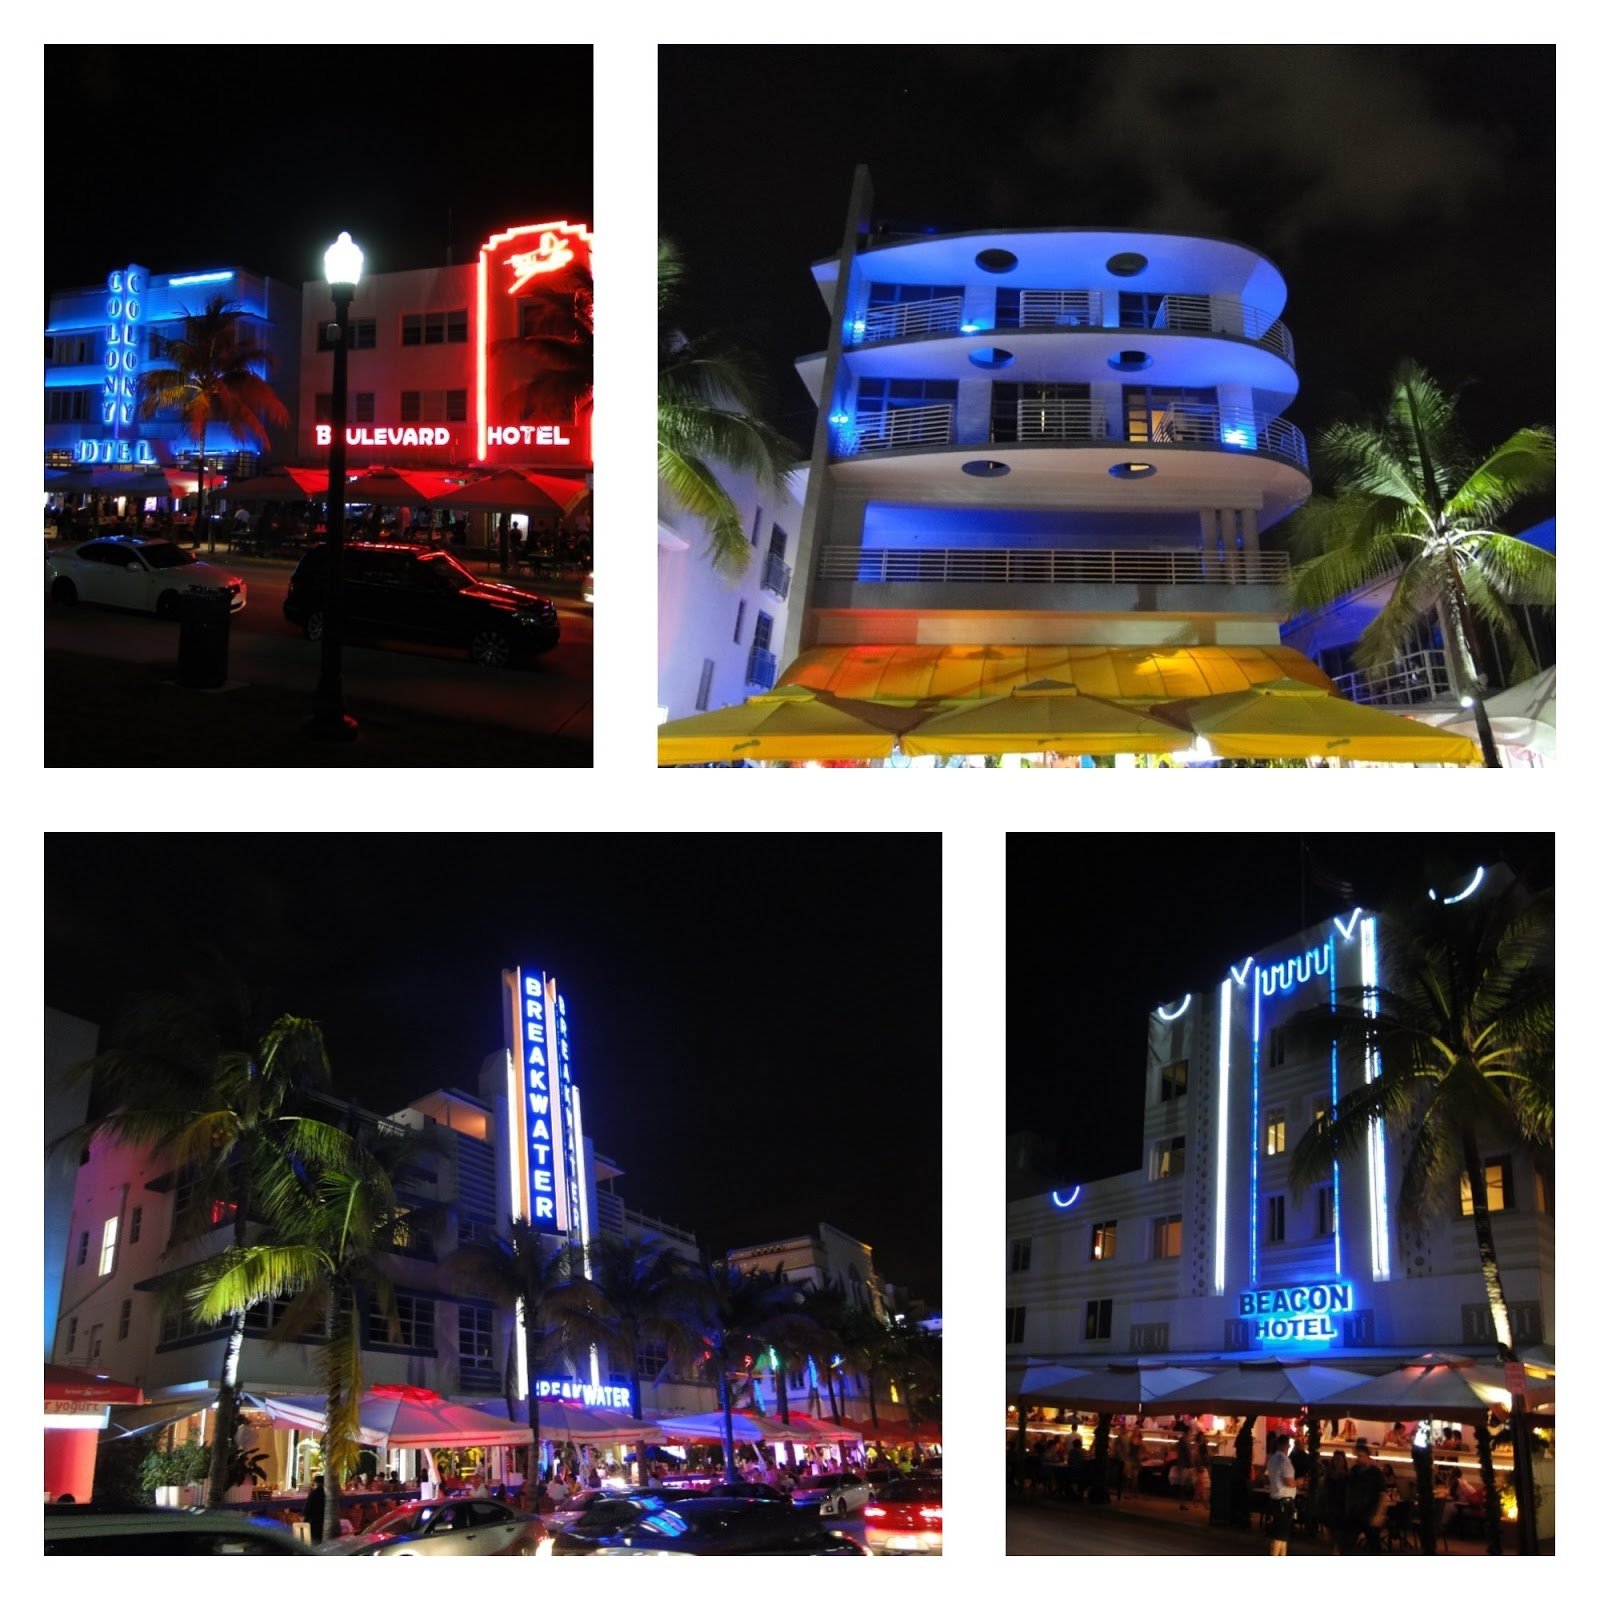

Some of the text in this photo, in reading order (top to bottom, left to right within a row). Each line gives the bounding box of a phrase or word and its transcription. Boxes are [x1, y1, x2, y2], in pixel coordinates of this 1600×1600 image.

[103, 270, 122, 424] COLONY
[121, 273, 140, 424] COLONY
[316, 425, 570, 446] BULEVARD HOTEL
[525, 976, 554, 1218] BREAKWATER
[1240, 1284, 1353, 1316] BEACON
[1255, 1317, 1336, 1340] HOTEL
[55, 1402, 98, 1415] yogurt
